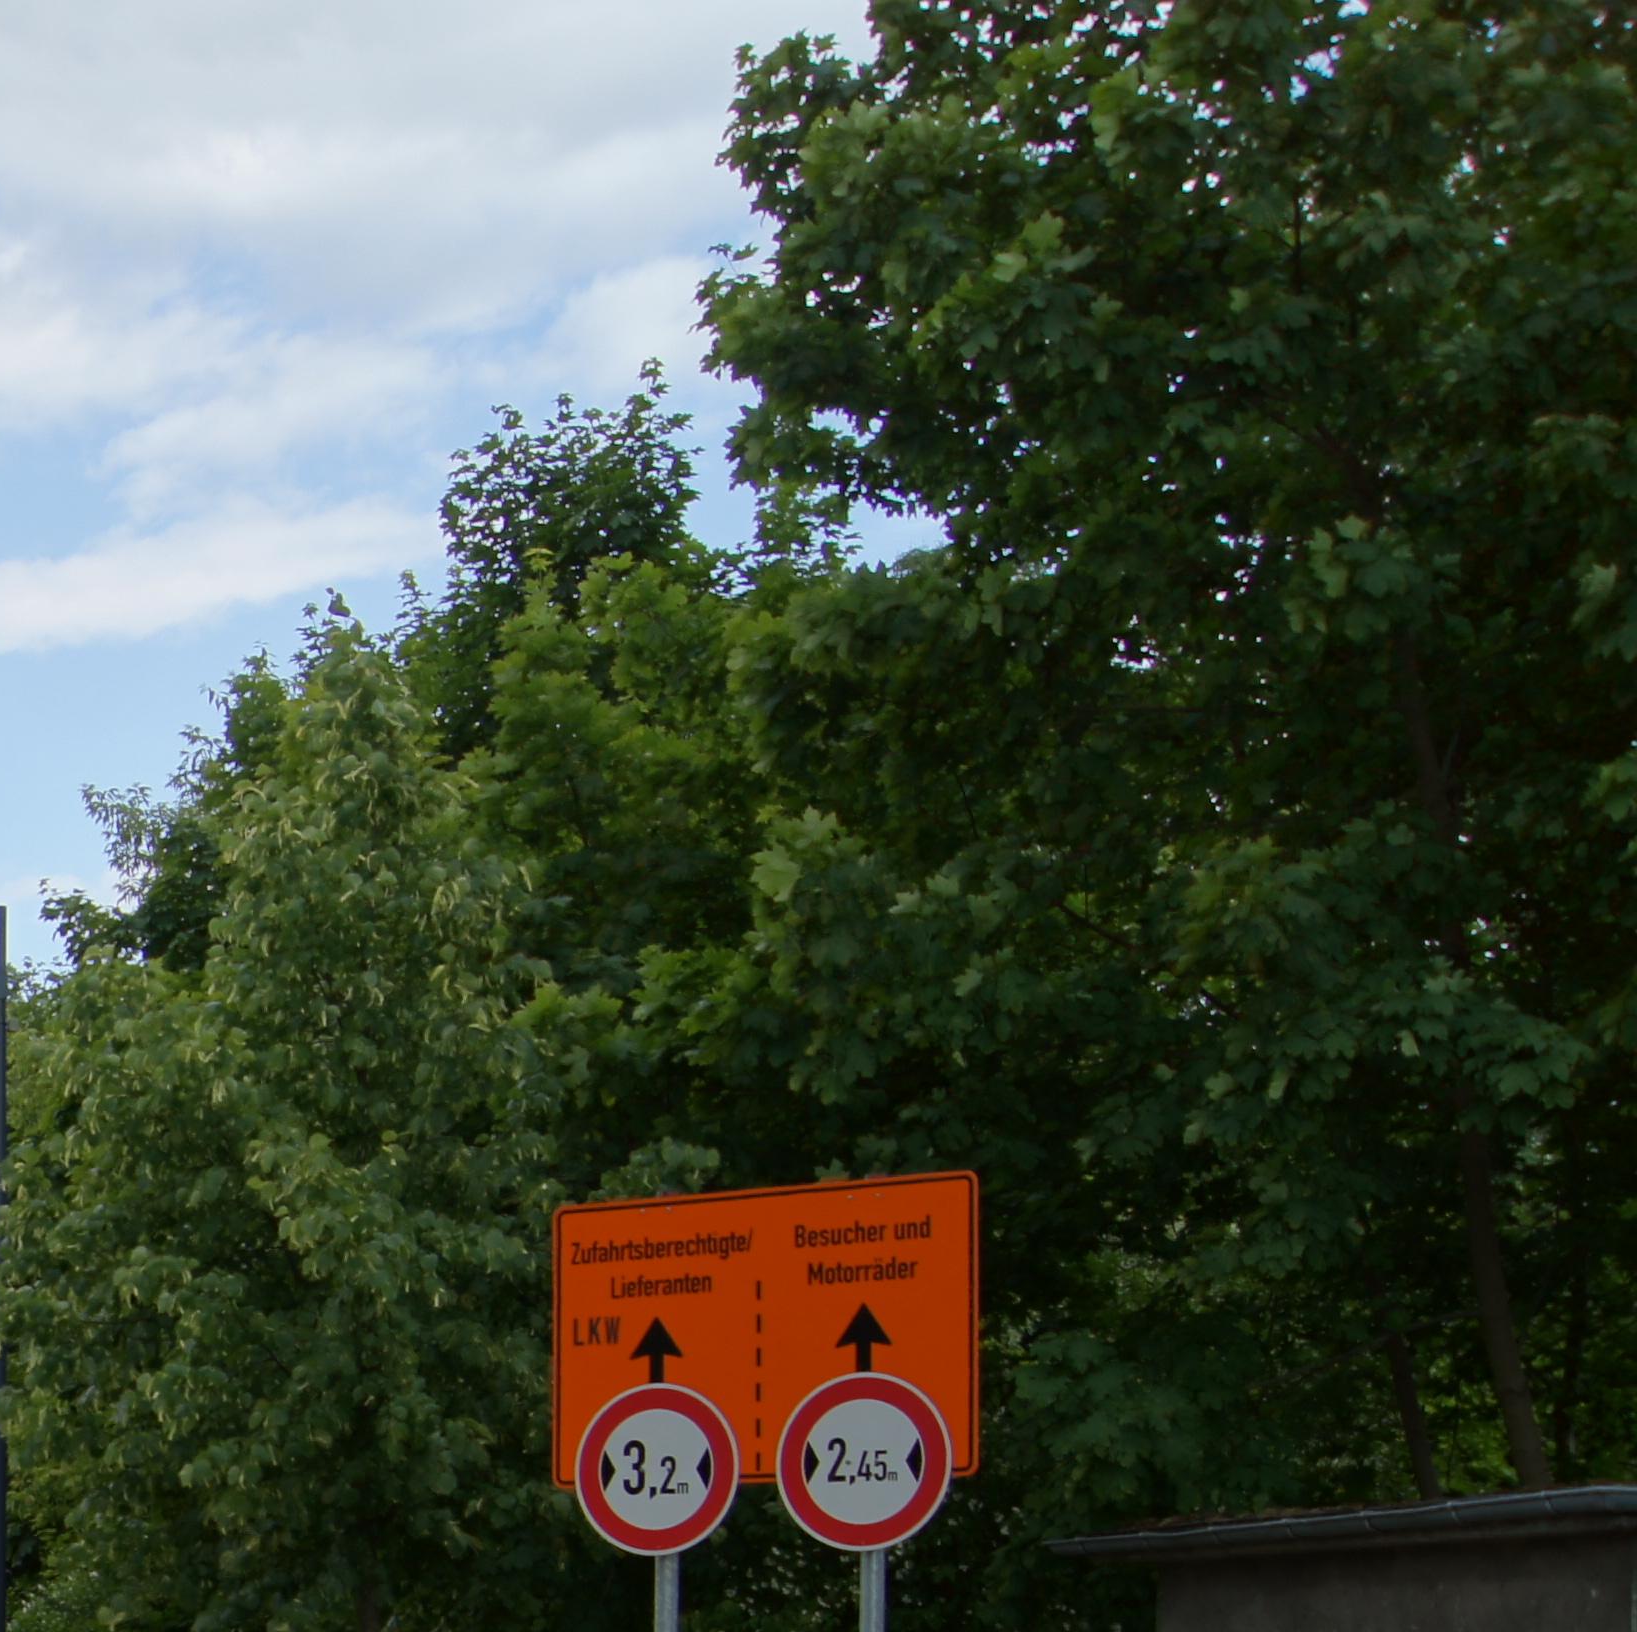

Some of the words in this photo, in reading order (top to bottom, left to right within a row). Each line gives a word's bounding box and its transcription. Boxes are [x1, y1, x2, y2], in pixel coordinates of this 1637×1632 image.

[571, 1227, 753, 1265] Zufahrtsberechtigte/
[794, 1219, 887, 1248] Besucher
[894, 1214, 931, 1240] und
[611, 1273, 712, 1299] Lieferanten
[807, 1256, 919, 1286] Motorräder
[573, 1316, 621, 1346] LKW
